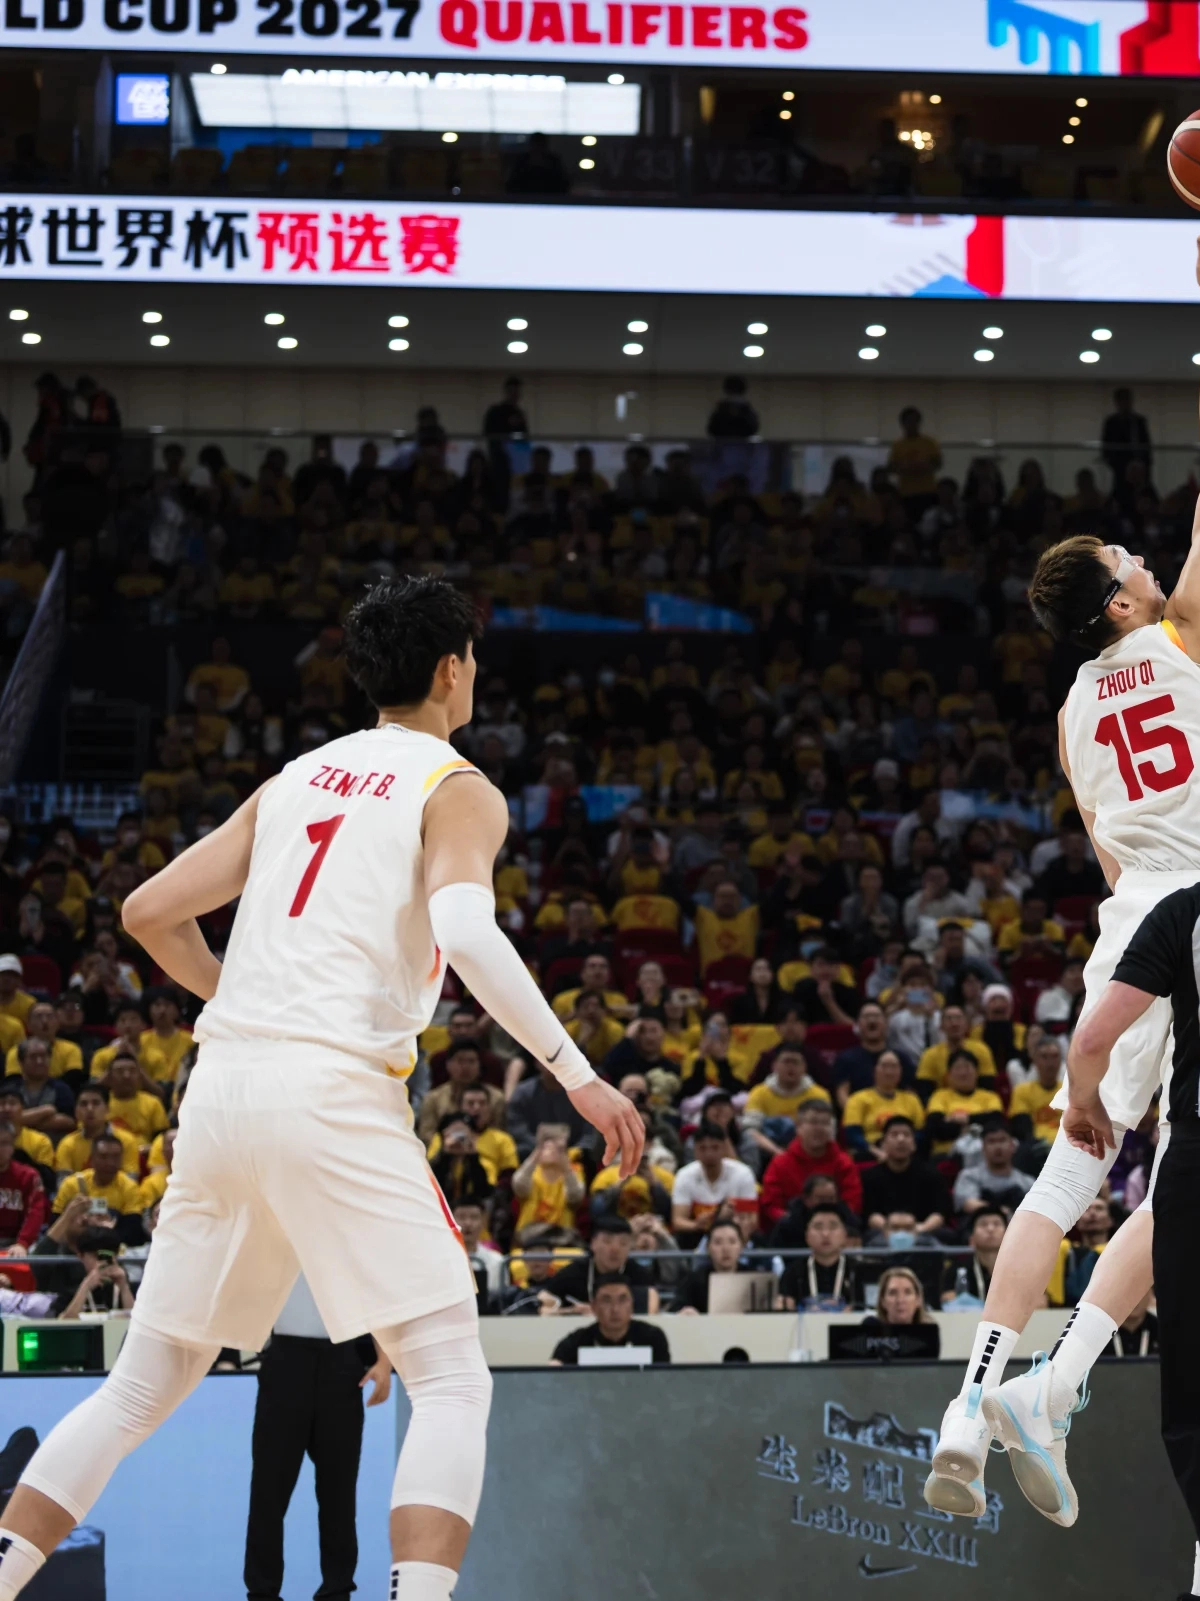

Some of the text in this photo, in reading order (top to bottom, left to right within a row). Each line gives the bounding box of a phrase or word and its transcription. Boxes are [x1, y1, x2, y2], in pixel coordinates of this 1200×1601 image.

[103, 0, 238, 35] CUP
[256, 0, 421, 39] 2027
[438, 0, 809, 50] QUALIFIERS
[1096, 659, 1155, 701] ZHOU QI
[1095, 694, 1194, 801] 15
[309, 765, 364, 797] ZEN
[288, 814, 345, 917] 1
[790, 1495, 979, 1567] LeBron XXIII
